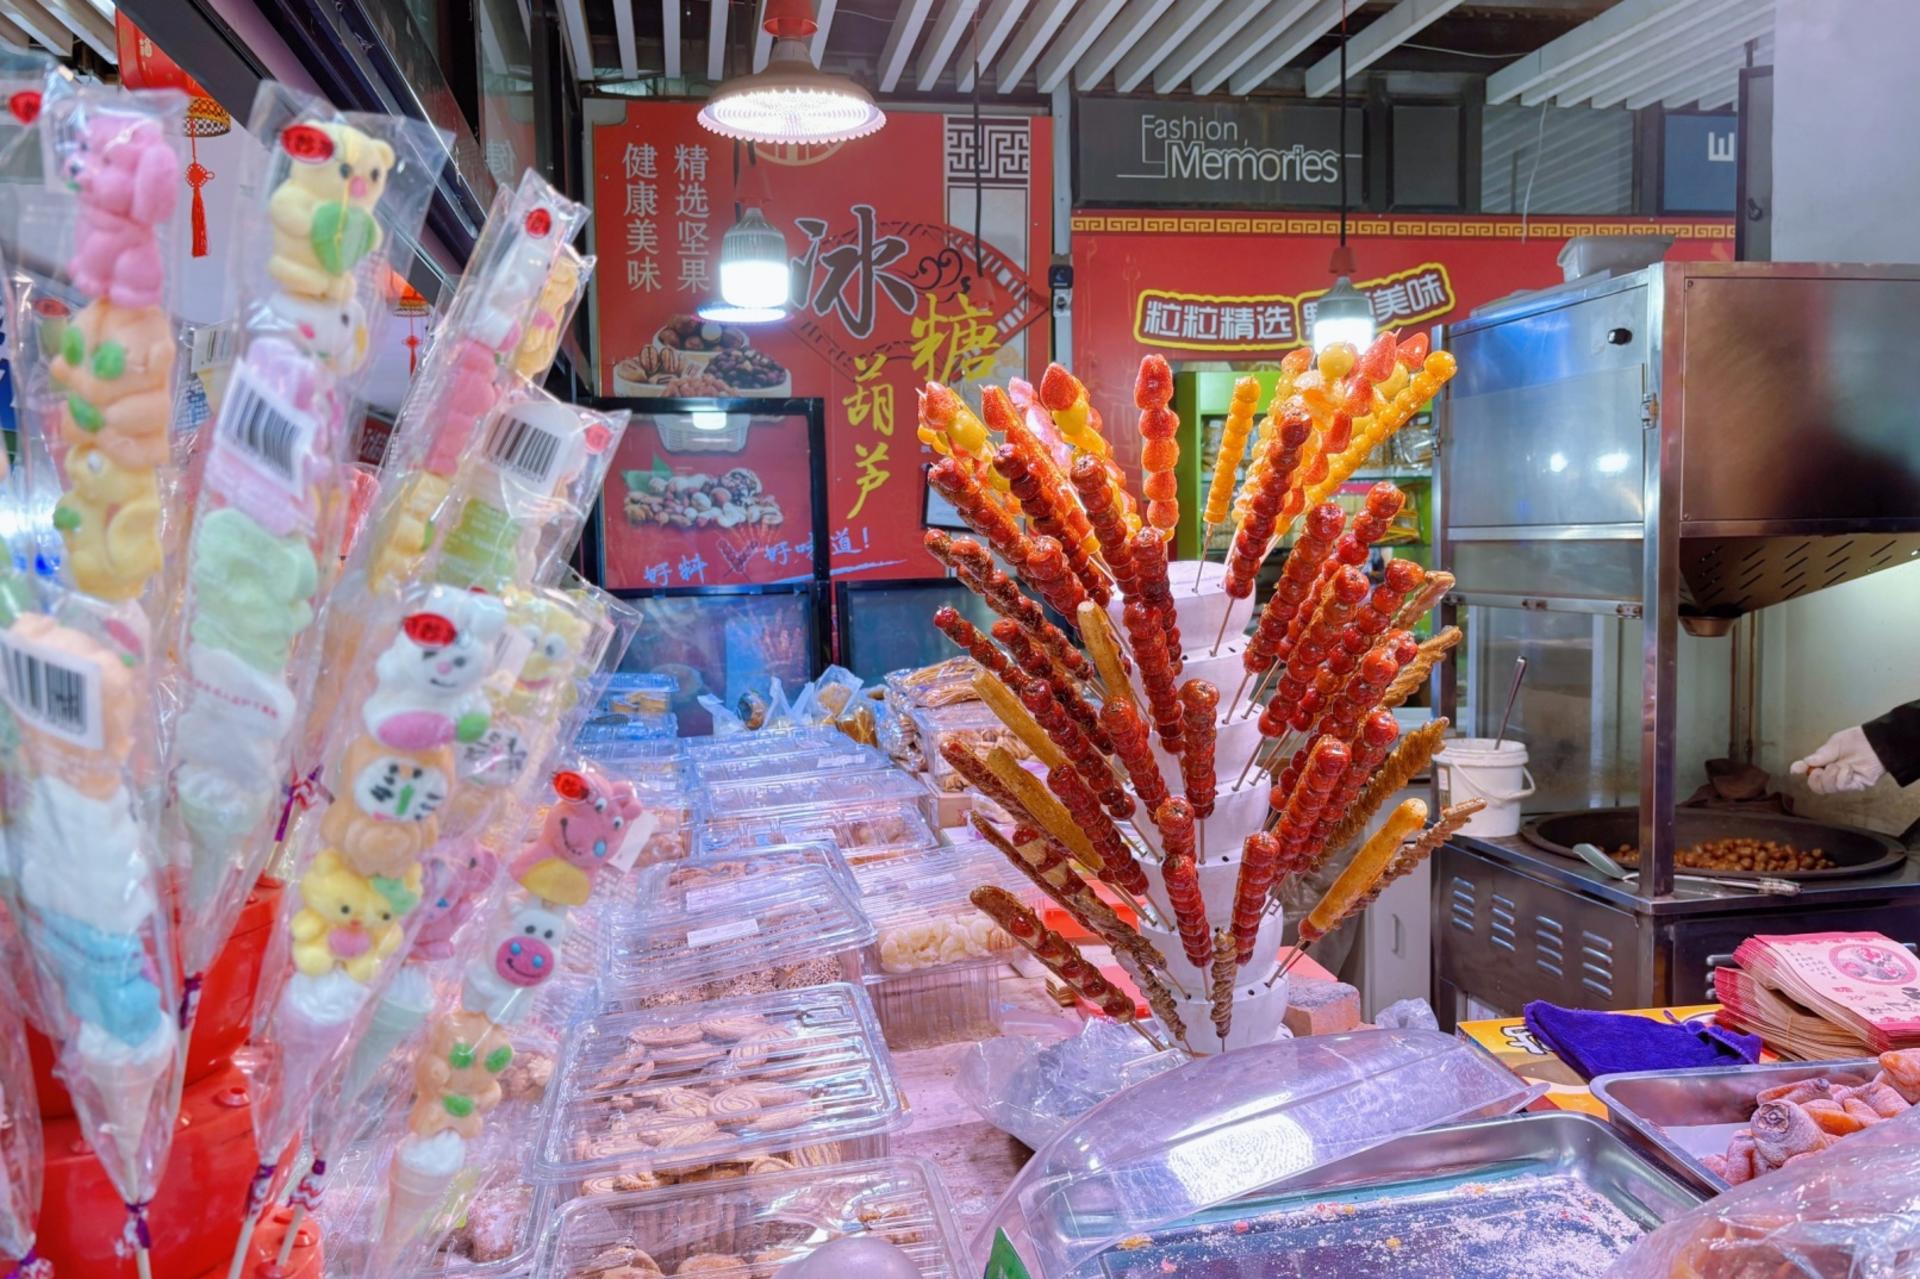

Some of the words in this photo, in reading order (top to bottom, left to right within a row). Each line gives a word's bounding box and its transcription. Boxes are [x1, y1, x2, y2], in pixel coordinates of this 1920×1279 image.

[1142, 114, 1238, 141] Fashion
[1168, 142, 1339, 183] Memories
[622, 142, 662, 293] 健康美味
[674, 143, 710, 294] 精选坚果
[1144, 300, 1292, 340] 粒粒精选
